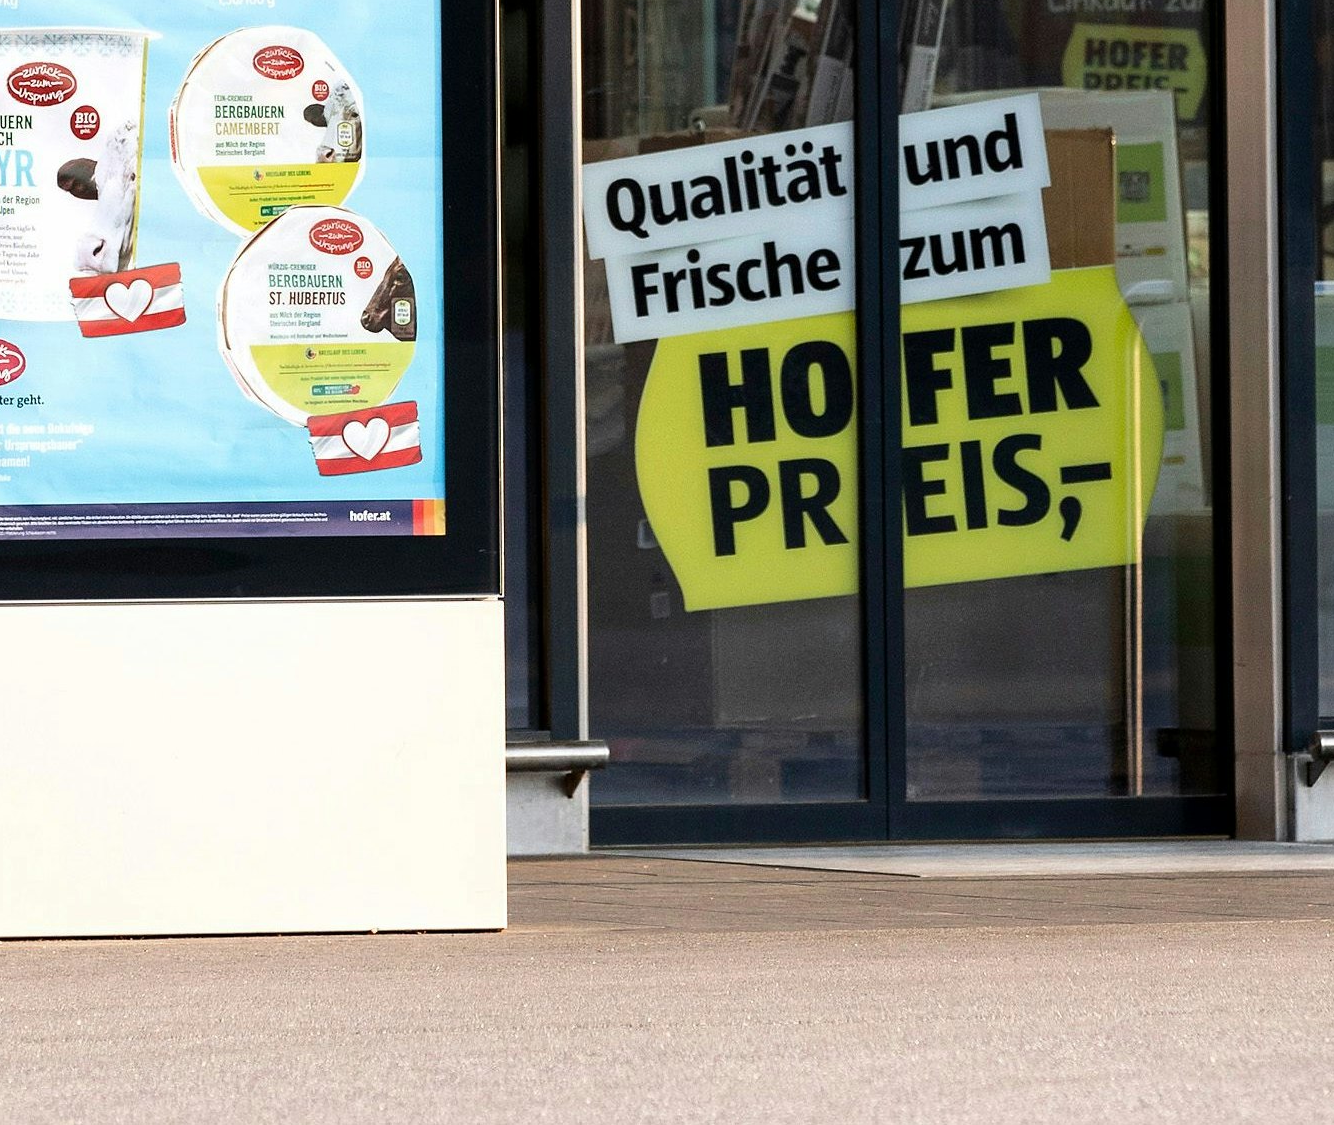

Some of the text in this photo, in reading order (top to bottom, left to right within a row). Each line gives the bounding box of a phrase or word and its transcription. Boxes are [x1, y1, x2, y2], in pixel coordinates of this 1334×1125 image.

[1084, 38, 1189, 71] HOFER
[22, 64, 62, 79] zurück
[29, 78, 52, 88] zum
[314, 84, 327, 92] BIO
[17, 88, 65, 105] Ursprung
[74, 112, 97, 124] BIO
[215, 105, 285, 119] BERGBAUERN
[215, 122, 281, 136] CAMEMBERT
[605, 113, 1024, 239] Qualität und
[15, 195, 40, 206] Region
[357, 261, 371, 269] BIO
[630, 220, 1026, 318] Frische zum
[269, 274, 343, 288] BERGBAUERN
[269, 291, 346, 305] ST. HUBERTUS
[698, 317, 1101, 447] HOFER
[17, 394, 45, 408] geht.
[349, 510, 392, 522] hofer.at
